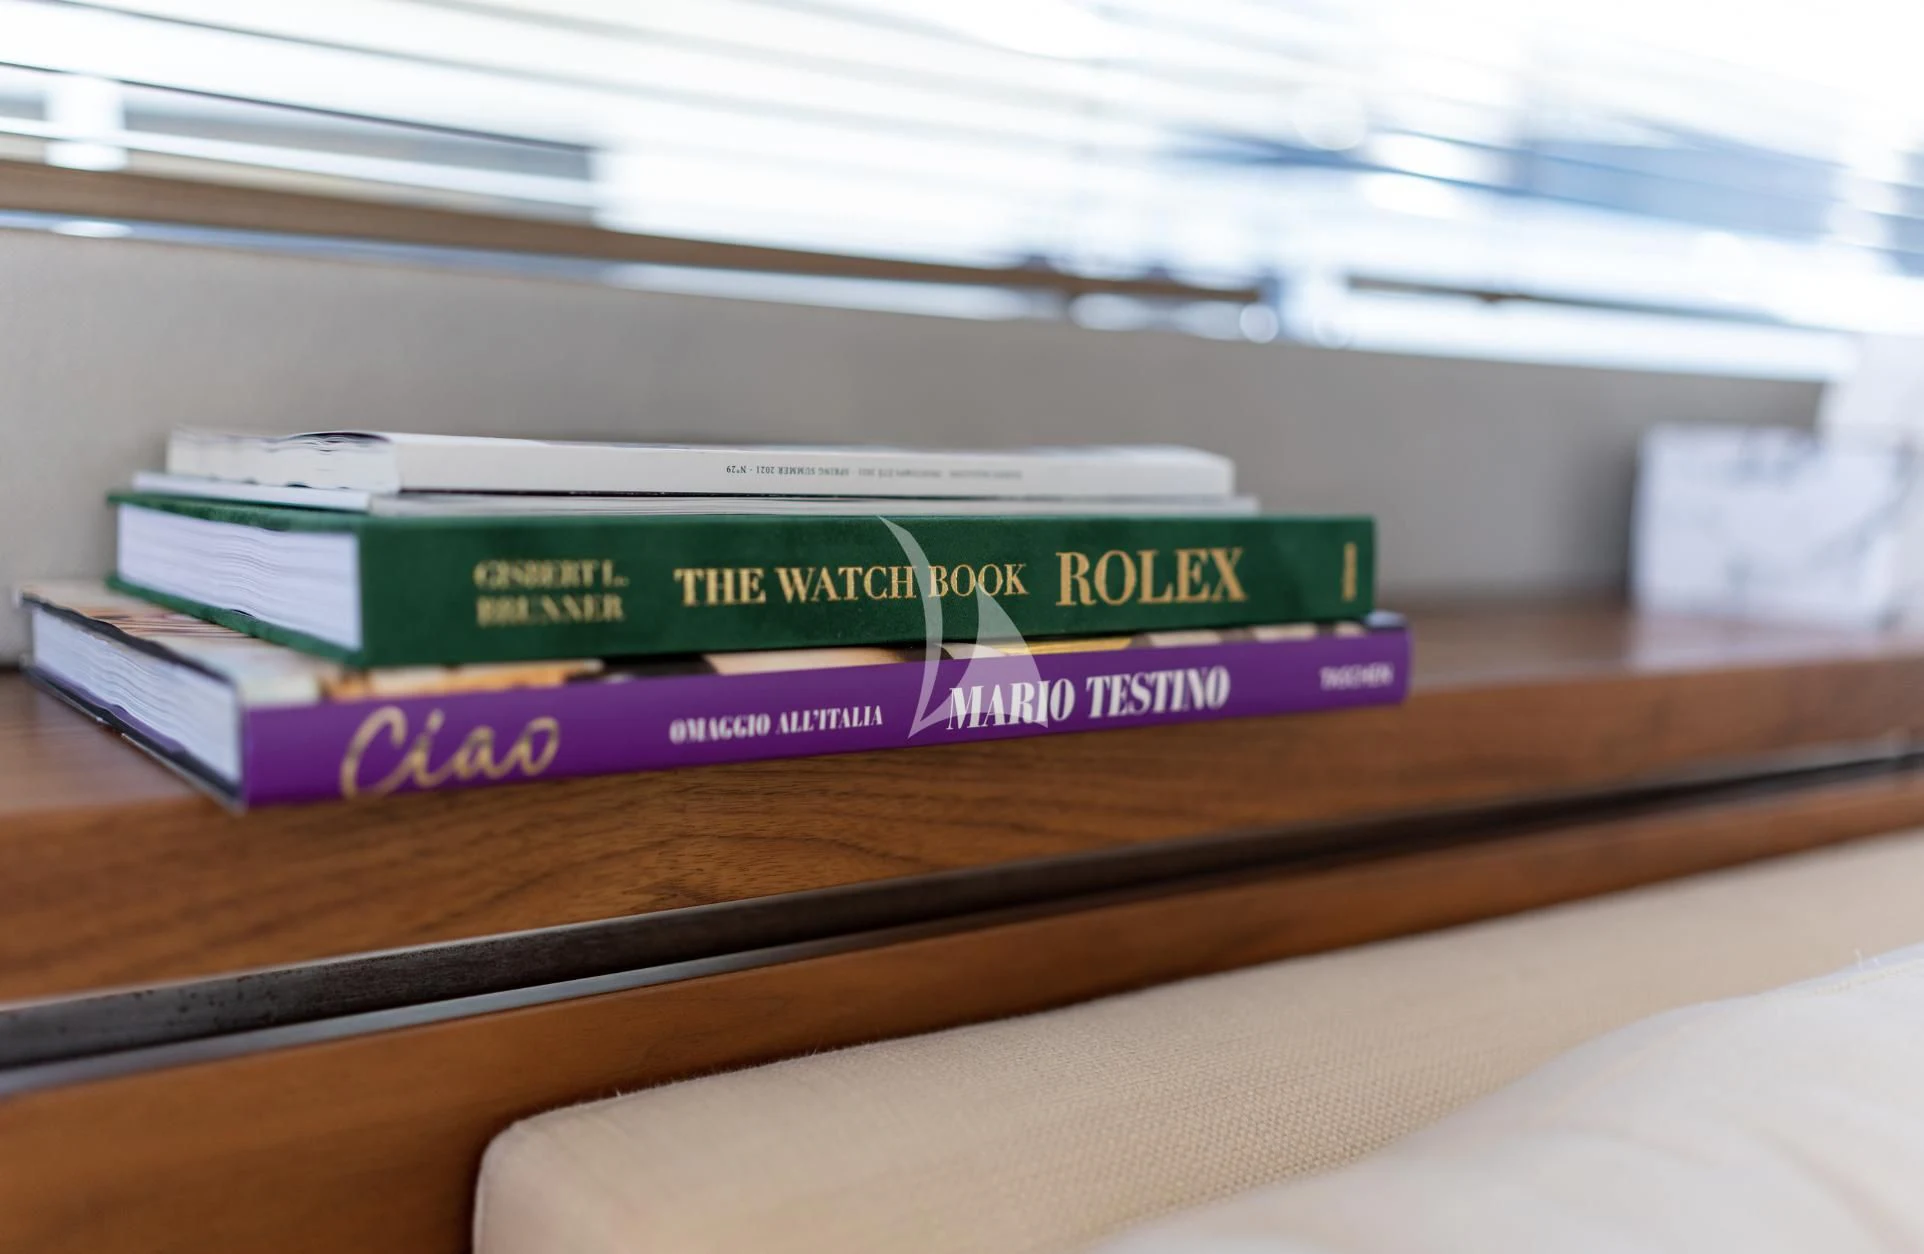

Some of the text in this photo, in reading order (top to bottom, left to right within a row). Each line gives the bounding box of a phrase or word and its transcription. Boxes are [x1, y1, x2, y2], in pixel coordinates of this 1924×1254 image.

[756, 466, 775, 475] 2021
[778, 466, 815, 476] SUMMER
[674, 547, 1247, 606] THE WATCH BOOK ROLEX
[947, 666, 1231, 730] MARIO TESTINO
[669, 713, 771, 745] OMAGGIO
[340, 706, 560, 799] Ciao
